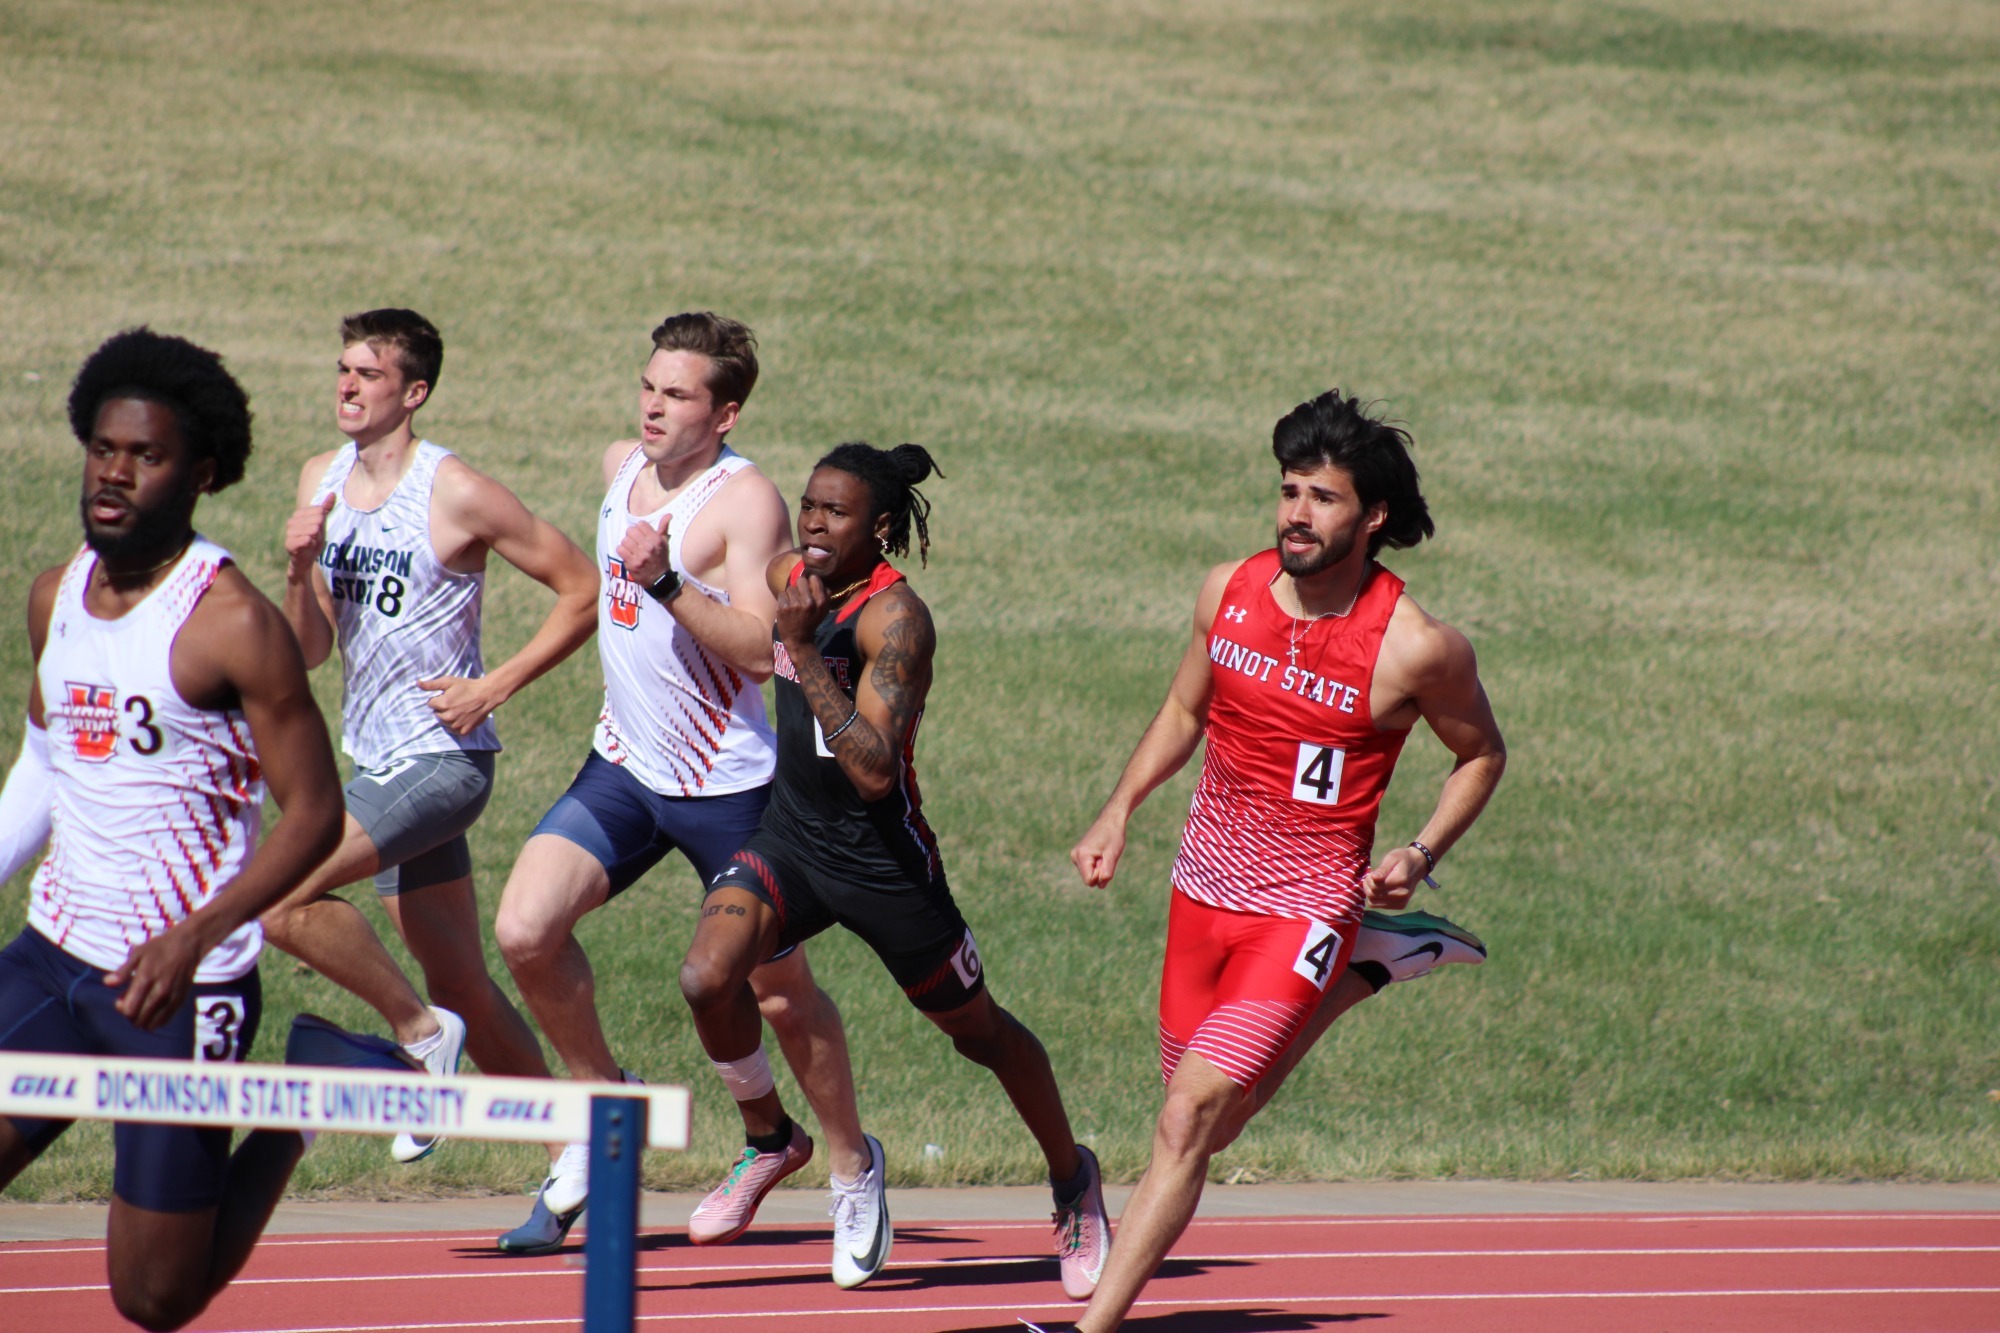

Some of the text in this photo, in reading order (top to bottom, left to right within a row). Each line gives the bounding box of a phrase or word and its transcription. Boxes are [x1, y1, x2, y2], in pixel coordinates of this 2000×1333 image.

[317, 541, 413, 577] ICKINSON
[332, 576, 375, 605] STAT
[376, 575, 405, 618] 8
[1210, 634, 1360, 714] MINOT STATE
[124, 695, 164, 756] 3
[1300, 747, 1335, 800] 4
[703, 904, 746, 918] LET GO
[961, 938, 979, 978] 6
[1304, 932, 1338, 983] 4
[203, 1001, 236, 1061] 3
[10, 1074, 78, 1098] GILL
[97, 1069, 467, 1128] DICKINSON STATE UNIVERSITY
[486, 1097, 555, 1122] GILL
